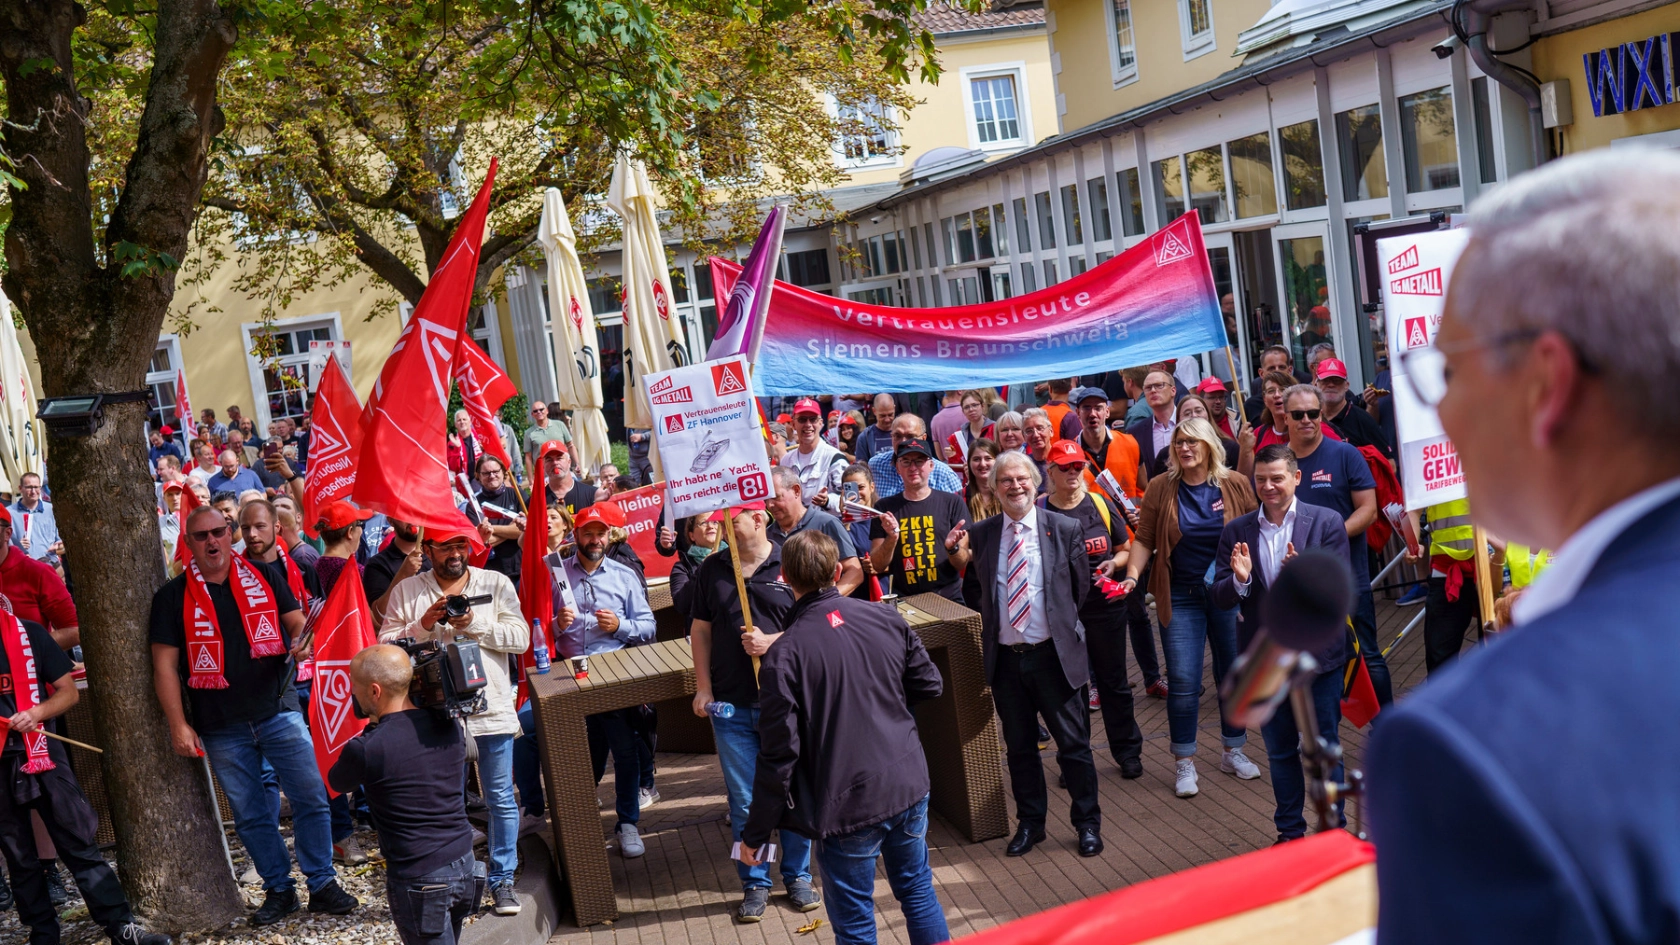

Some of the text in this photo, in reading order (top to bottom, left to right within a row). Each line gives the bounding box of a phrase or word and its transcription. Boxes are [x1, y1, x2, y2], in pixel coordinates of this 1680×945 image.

[1389, 247, 1418, 272] TEAM
[1401, 270, 1441, 294] METALL
[833, 290, 1091, 330] Vertrauensleute
[807, 319, 1130, 359] Siemens Braunschweig
[650, 378, 672, 393] TEAM
[660, 388, 691, 403] METALL
[684, 401, 746, 418] Vertrauensleute
[687, 411, 743, 430] ZF Hannover
[670, 480, 683, 490] Ihr
[685, 473, 708, 486] habt
[728, 462, 760, 476] Yacht,
[673, 475, 766, 503] uns reicht die 8!
[469, 663, 479, 680] 1
